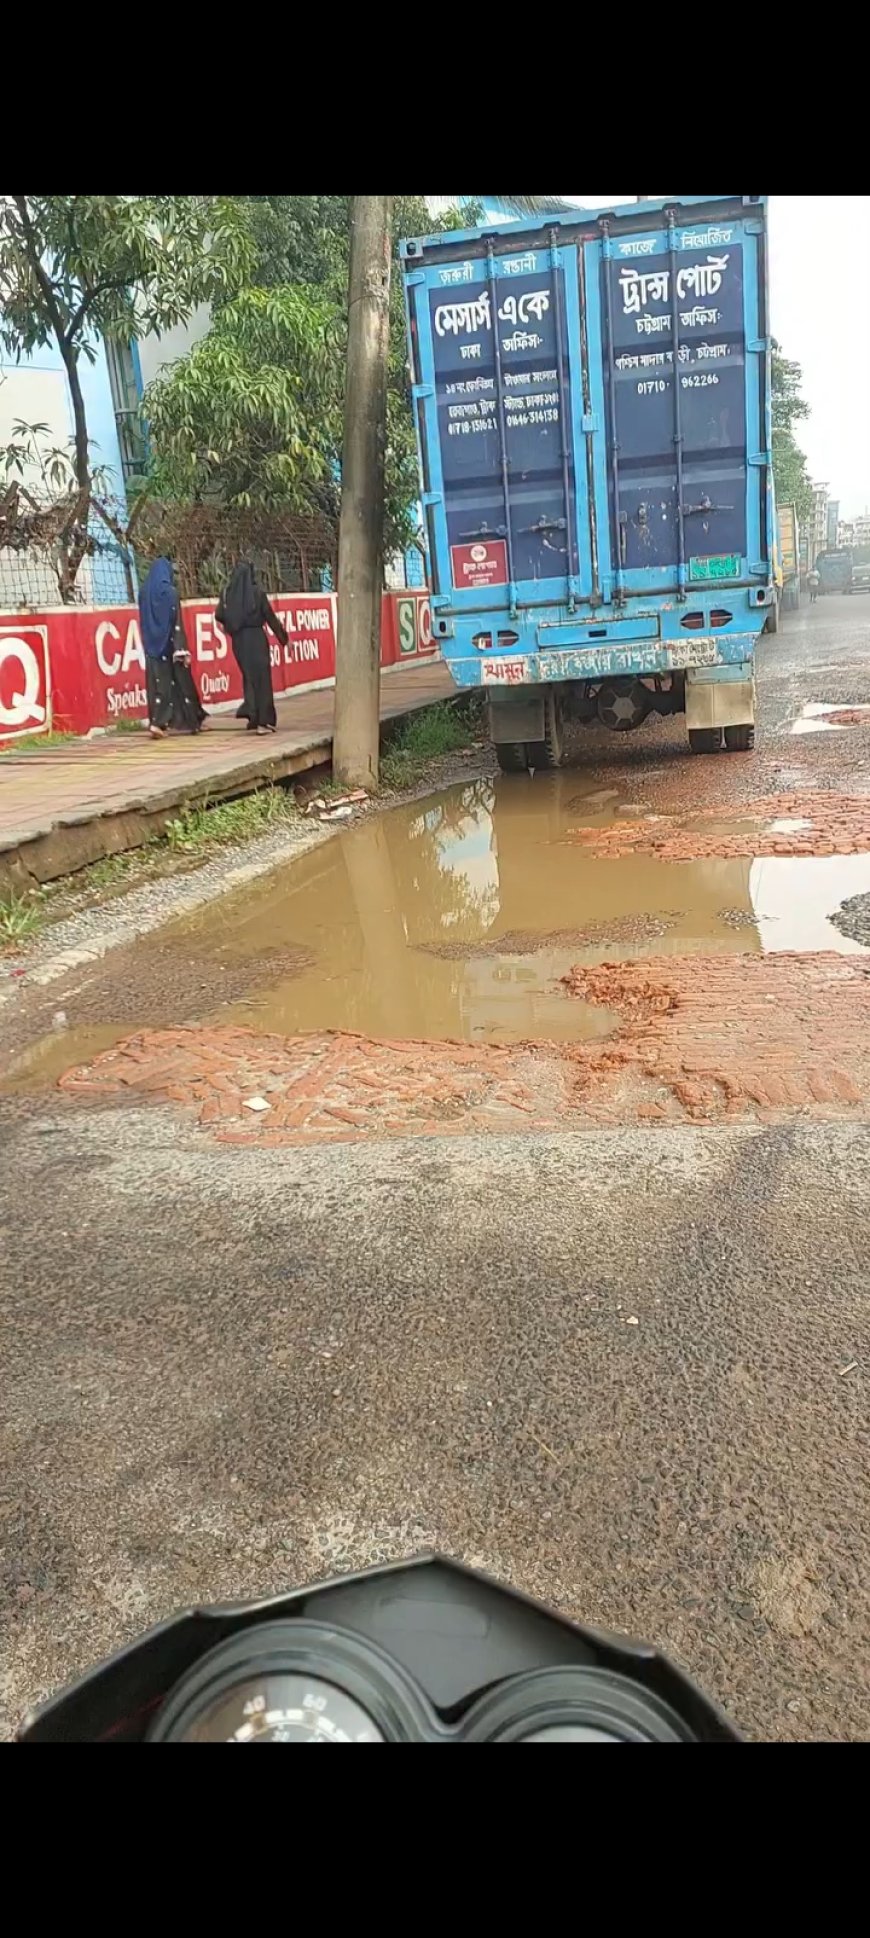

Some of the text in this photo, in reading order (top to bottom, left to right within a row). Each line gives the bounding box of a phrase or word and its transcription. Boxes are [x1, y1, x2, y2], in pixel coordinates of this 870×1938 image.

[618, 239, 657, 256] কাজে
[434, 254, 730, 337] মেসার্স একে ট্রান্স পোর্ট
[459, 343, 482, 360] ঢাকা
[681, 374, 719, 389] 962266
[484, 661, 525, 681] থামুন
[243, 1695, 266, 1715] 40
